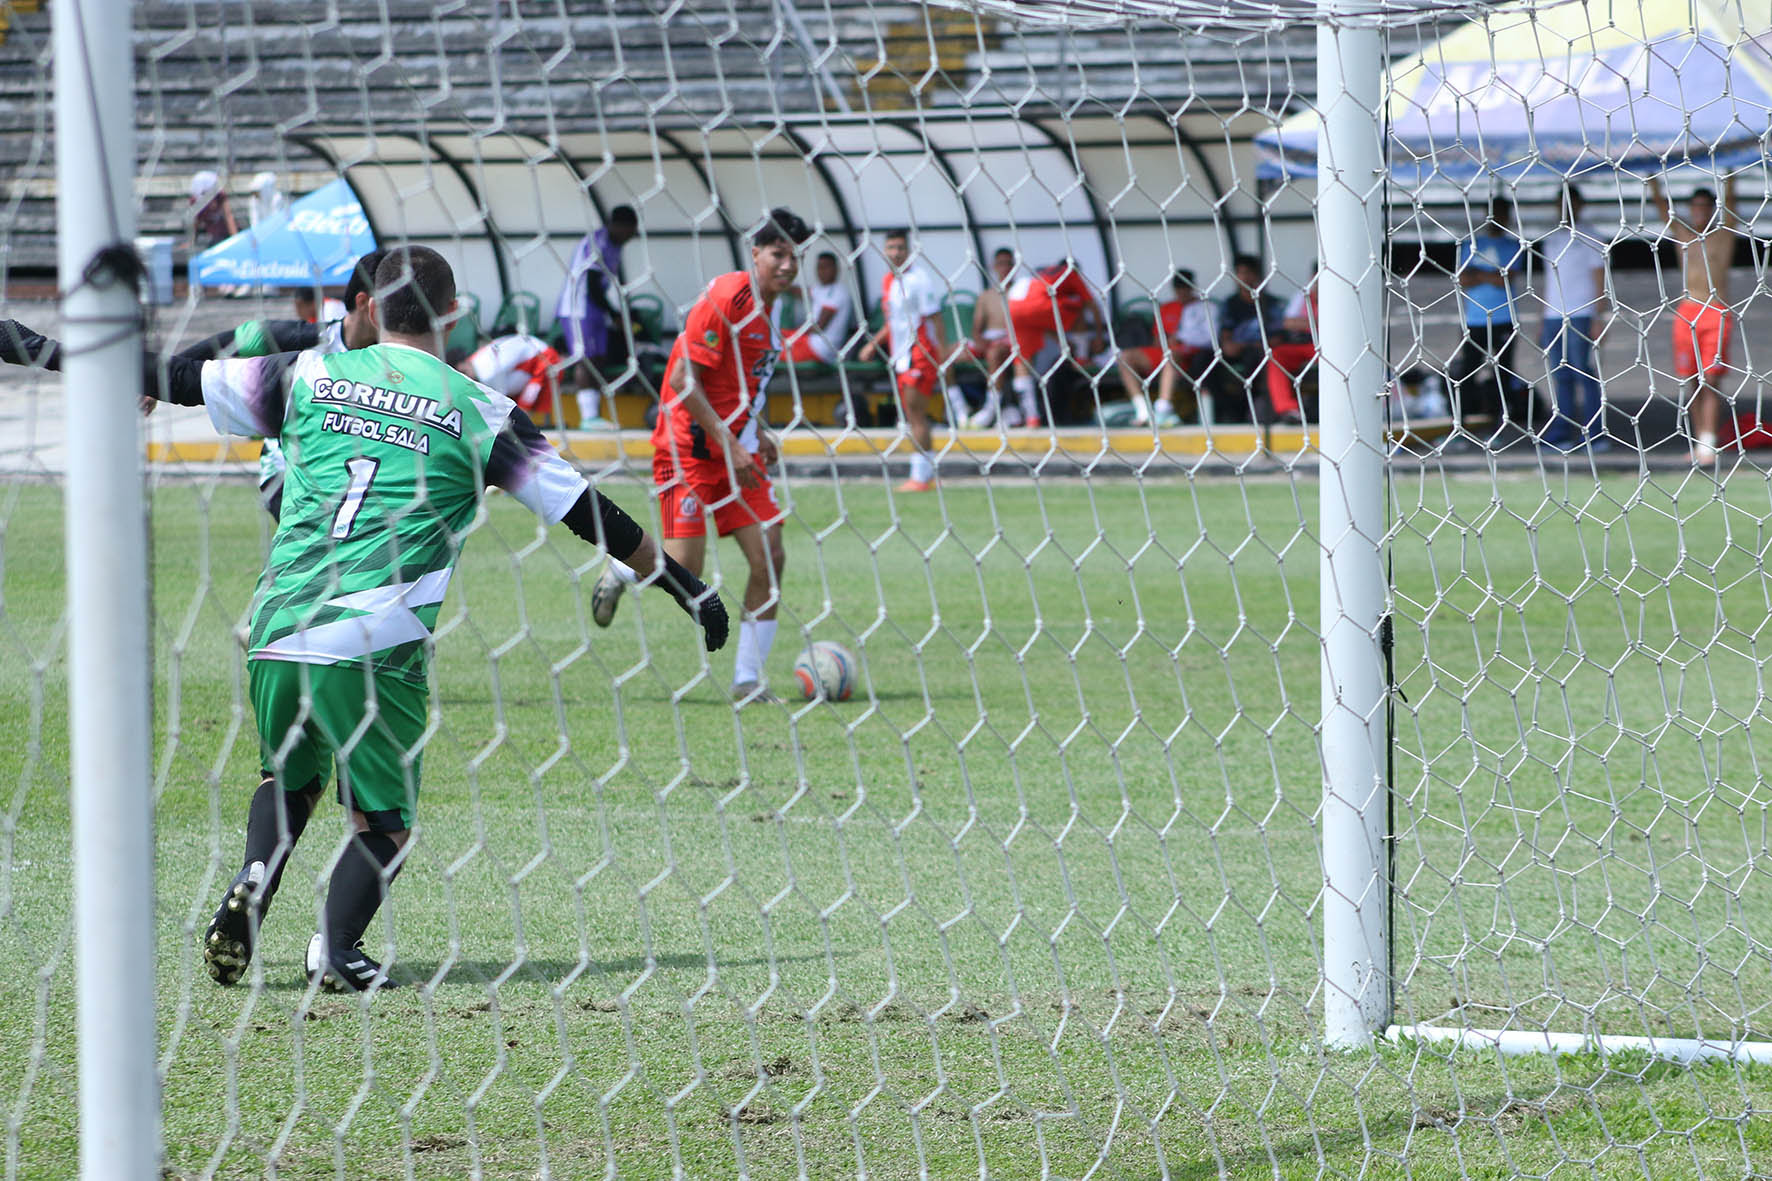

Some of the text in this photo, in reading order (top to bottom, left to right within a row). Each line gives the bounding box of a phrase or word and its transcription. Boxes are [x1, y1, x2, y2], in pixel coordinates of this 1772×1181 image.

[313, 377, 463, 436] CORHUILA
[321, 411, 430, 456] FUTBOL SALA
[331, 455, 381, 540] 1
